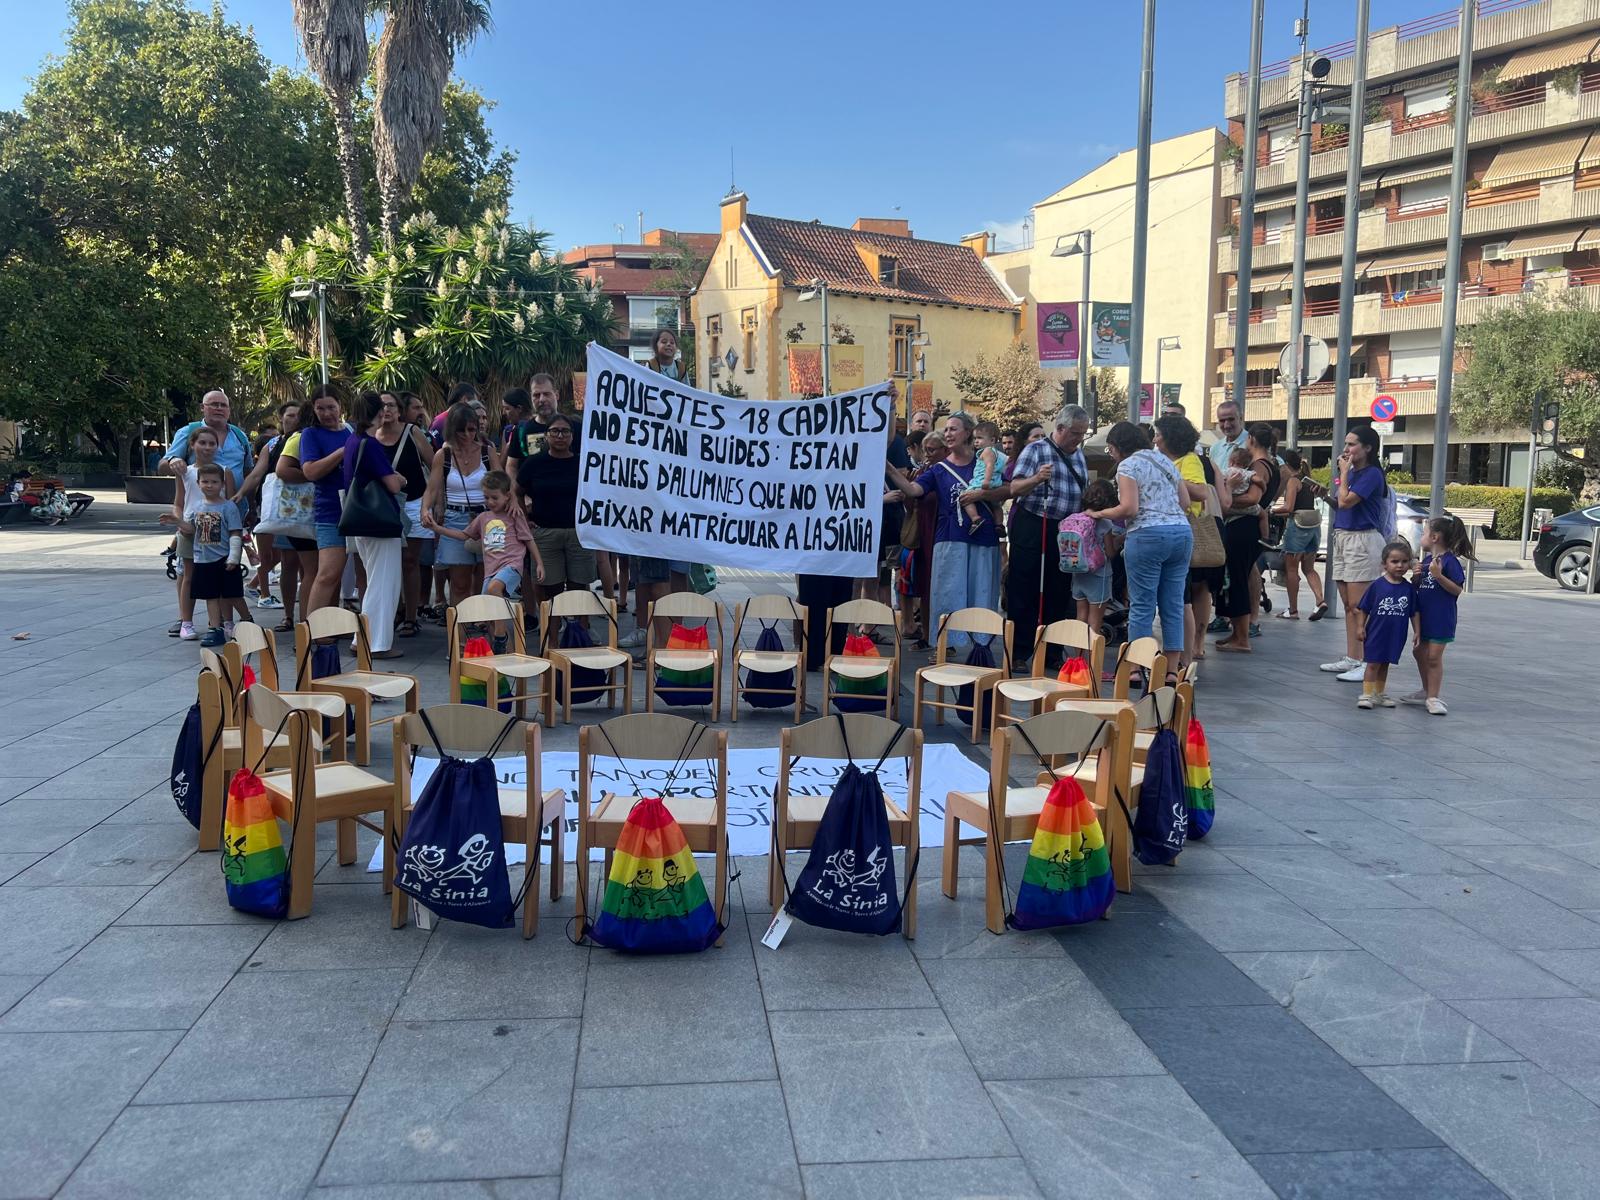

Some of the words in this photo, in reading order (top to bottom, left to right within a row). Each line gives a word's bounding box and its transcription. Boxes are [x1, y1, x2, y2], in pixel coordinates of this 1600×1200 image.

[596, 369, 726, 430] AQUESTES
[739, 407, 770, 435] 18
[777, 390, 889, 437] CADIRES
[588, 410, 621, 442] NO
[625, 417, 688, 457] ESTAN
[789, 441, 859, 470] ESTAN
[583, 451, 649, 491] PLENES
[656, 463, 744, 506] D'ALUMNES
[749, 480, 785, 511] QUE
[789, 483, 817, 511] NO
[824, 482, 866, 511] VAN
[784, 521, 799, 550] A
[401, 872, 422, 892] La
[813, 879, 834, 900] La
